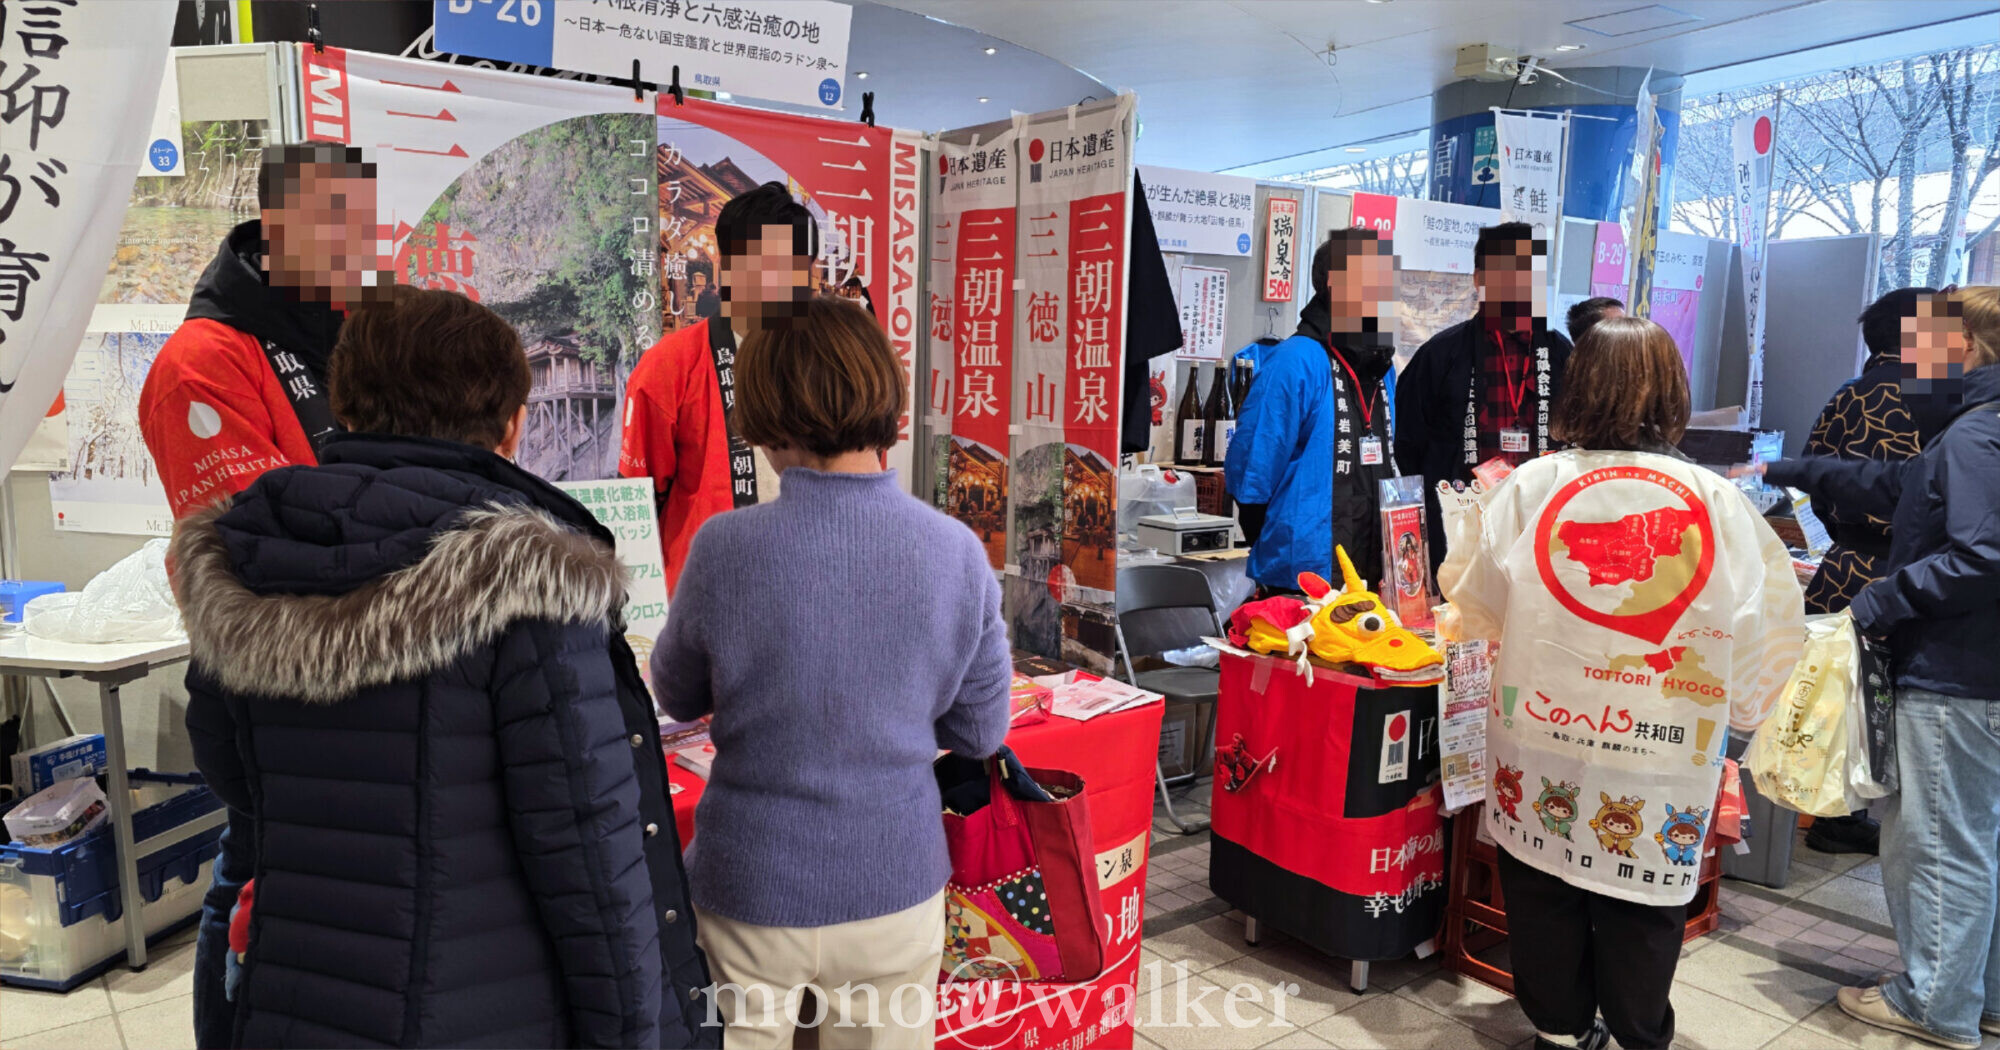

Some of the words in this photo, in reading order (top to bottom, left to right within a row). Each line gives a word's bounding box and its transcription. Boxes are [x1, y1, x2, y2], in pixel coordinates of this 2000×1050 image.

[694, 73, 721, 87] 鳥取県
[158, 156, 171, 167] 33
[948, 148, 1008, 177] 日本遺産
[1051, 129, 1116, 164] 日本遺産
[1515, 148, 1553, 164] 日本遺産
[967, 175, 1007, 189] HERITAGE
[1077, 158, 1116, 176] HERITAGE
[664, 141, 689, 318] カラダ癒し
[815, 135, 876, 312] 三朝
[628, 138, 657, 350] ココロ清める
[1598, 242, 1624, 266] B-29
[1268, 279, 1291, 297] 500
[957, 216, 1006, 419] 三朝温泉
[1025, 211, 1061, 423] 三徳山
[1073, 203, 1114, 425] 三朝温泉
[266, 341, 318, 402] 取県
[193, 444, 254, 475] MISASA
[731, 434, 755, 495] 三朝町
[1583, 666, 1651, 687] TOTTORI
[1663, 677, 1726, 699] HYOGO
[1096, 847, 1133, 880] ン泉
[1565, 847, 1593, 868] no
